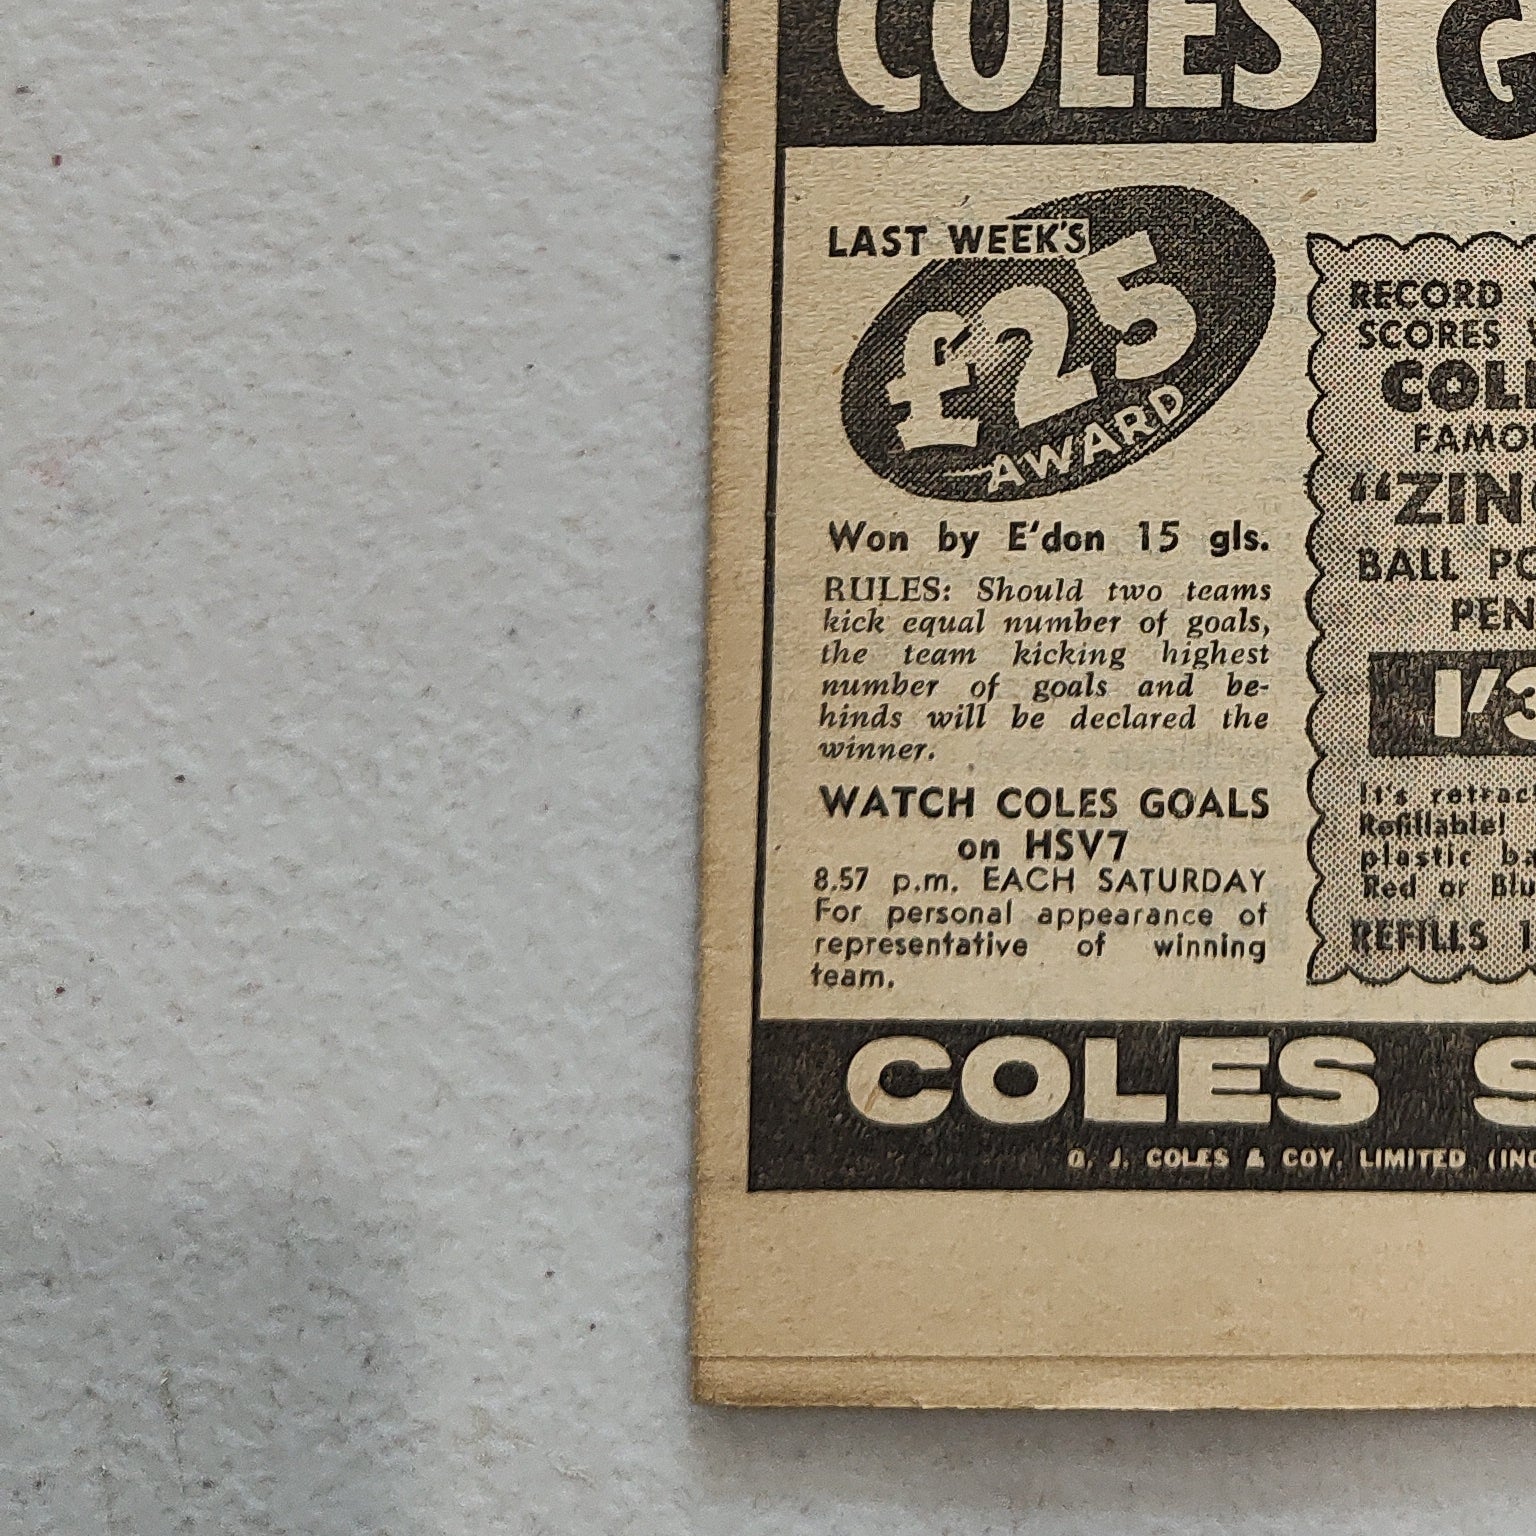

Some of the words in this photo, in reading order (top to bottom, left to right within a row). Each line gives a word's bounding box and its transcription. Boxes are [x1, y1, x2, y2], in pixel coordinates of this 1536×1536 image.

[827, 224, 928, 258] LAST
[948, 221, 1086, 255] WEEK'S
[1350, 280, 1501, 310] RECORD
[889, 230, 1197, 451] £25
[1358, 319, 1500, 350] SCORES
[987, 385, 1184, 491] AWARD
[827, 519, 909, 554] Won
[937, 519, 981, 560] by
[1007, 519, 1105, 555] E'don
[1134, 519, 1180, 554] 15
[1209, 519, 1271, 558] gls.
[1356, 547, 1459, 582] BALL
[824, 575, 952, 603] RULES:
[976, 575, 1084, 603] Should
[1107, 581, 1163, 603] two
[1186, 580, 1272, 602] teams
[823, 606, 885, 635] kick
[902, 607, 986, 639] equal
[1003, 606, 1122, 636] number
[1137, 607, 1169, 639] of
[1186, 606, 1270, 640] goals,
[1452, 597, 1534, 631] PEN
[820, 638, 869, 665] the
[902, 644, 978, 667] team
[1012, 638, 1127, 672] kicking
[1161, 638, 1270, 671] highest
[821, 670, 940, 699] number
[969, 671, 1001, 703] of
[1031, 670, 1108, 704] goals
[1137, 671, 1195, 699] and
[1226, 670, 1270, 698] be-
[818, 701, 903, 731] hinds
[926, 703, 987, 730] will
[1010, 702, 1045, 731] be
[1069, 703, 1197, 731] declared
[1222, 702, 1269, 730] the
[817, 734, 935, 764] winner.
[817, 784, 976, 821] WATCH
[996, 786, 1118, 821] COLES
[1139, 786, 1270, 822] GOALS
[957, 838, 1001, 863] on
[1025, 827, 1129, 863] HSV7
[1361, 840, 1471, 874] plastic
[813, 865, 869, 893] 8.57
[892, 872, 959, 898] p.m.
[983, 865, 1075, 895] EACH
[1098, 866, 1267, 897] SATURDAY
[1363, 874, 1416, 899] Red
[1439, 878, 1469, 898] or
[814, 896, 863, 924] For
[886, 897, 1013, 933] personal
[1036, 906, 1214, 933] appearance
[1238, 901, 1269, 928] of
[814, 930, 1028, 963] representative
[1076, 929, 1107, 958] of
[1153, 931, 1266, 966] winning
[1351, 920, 1488, 953] REFILLS
[810, 961, 895, 991] team.
[847, 1035, 1379, 1127] COLES
[1146, 1148, 1230, 1168] COLES
[1359, 1148, 1466, 1169] LIMITED
